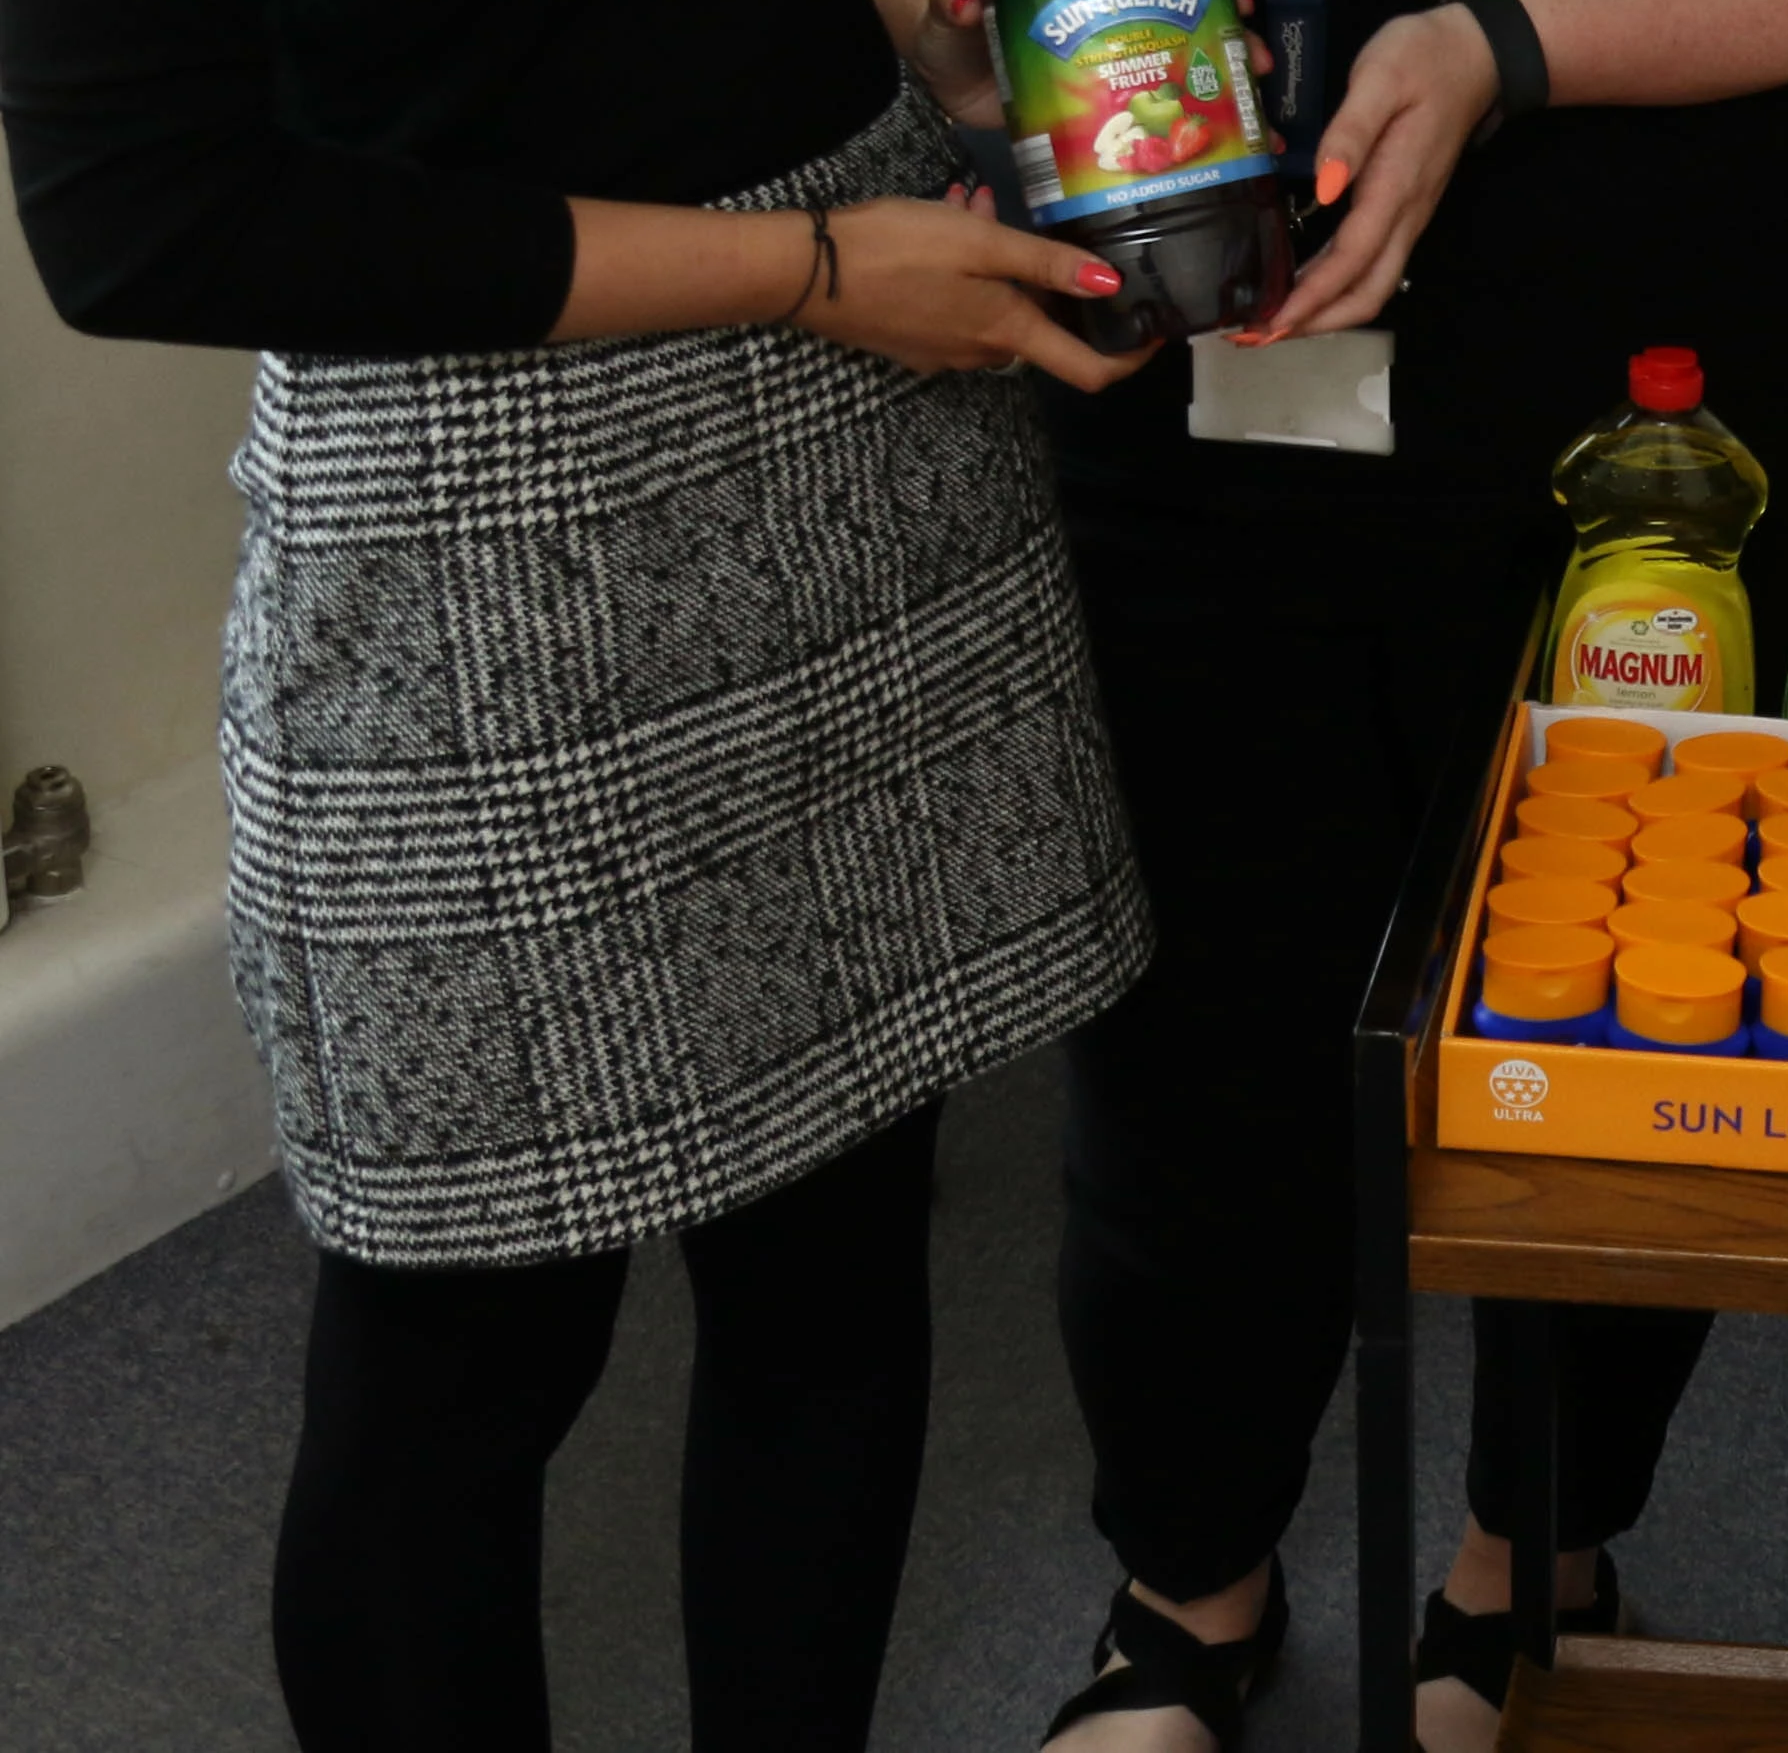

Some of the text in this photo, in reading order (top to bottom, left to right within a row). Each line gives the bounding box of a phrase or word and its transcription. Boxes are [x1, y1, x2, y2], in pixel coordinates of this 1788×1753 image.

[1097, 50, 1174, 79] SUMMER
[1108, 66, 1169, 92] FRUITS
[1106, 168, 1222, 206] NO ADDED SUGAR
[1579, 644, 1704, 686] MAGNUM
[1616, 687, 1656, 700] lemon
[1501, 1064, 1536, 1077] UVA
[1493, 1107, 1545, 1123] ULTRA
[1652, 1099, 1744, 1136] SUN
